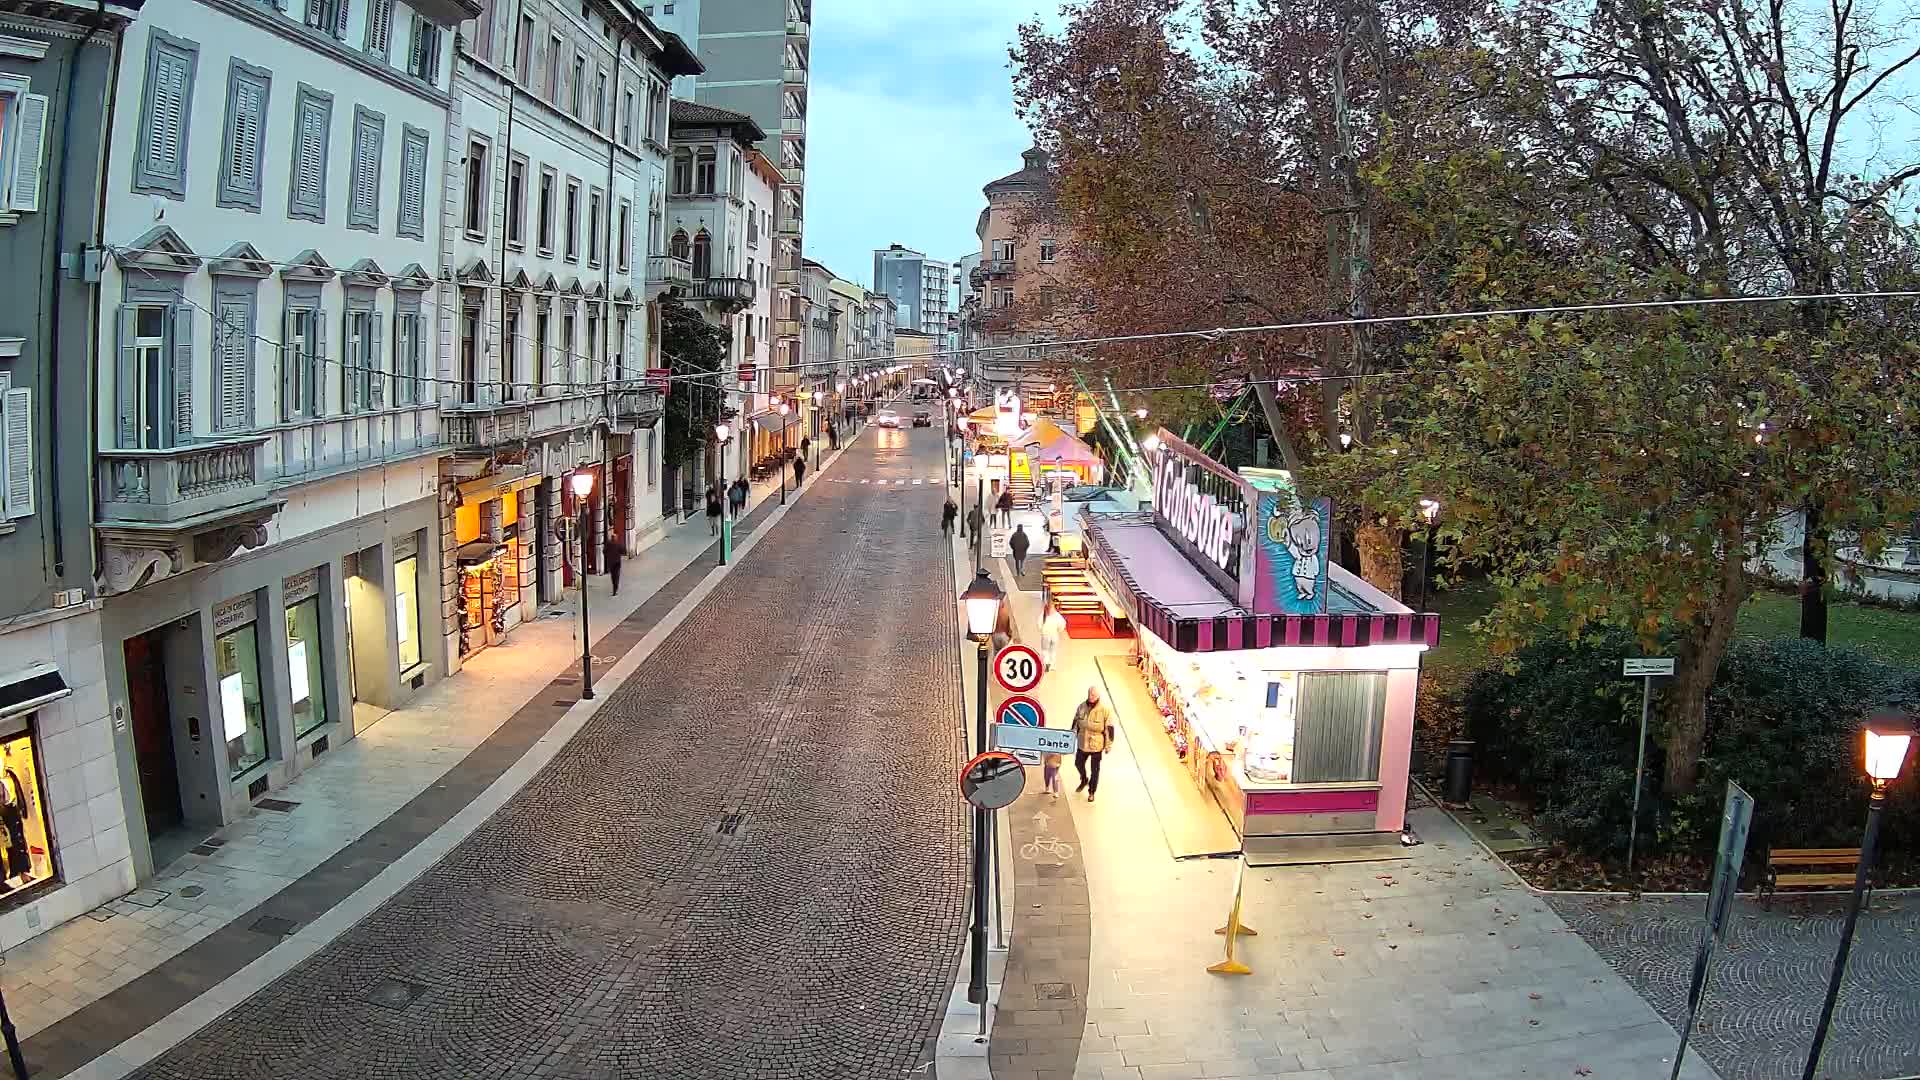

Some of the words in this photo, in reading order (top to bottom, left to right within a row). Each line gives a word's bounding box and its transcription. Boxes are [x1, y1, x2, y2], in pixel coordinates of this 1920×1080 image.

[1162, 459, 1233, 569] Golosone
[1006, 658, 1033, 680] 30
[1038, 737, 1070, 749] Dante
